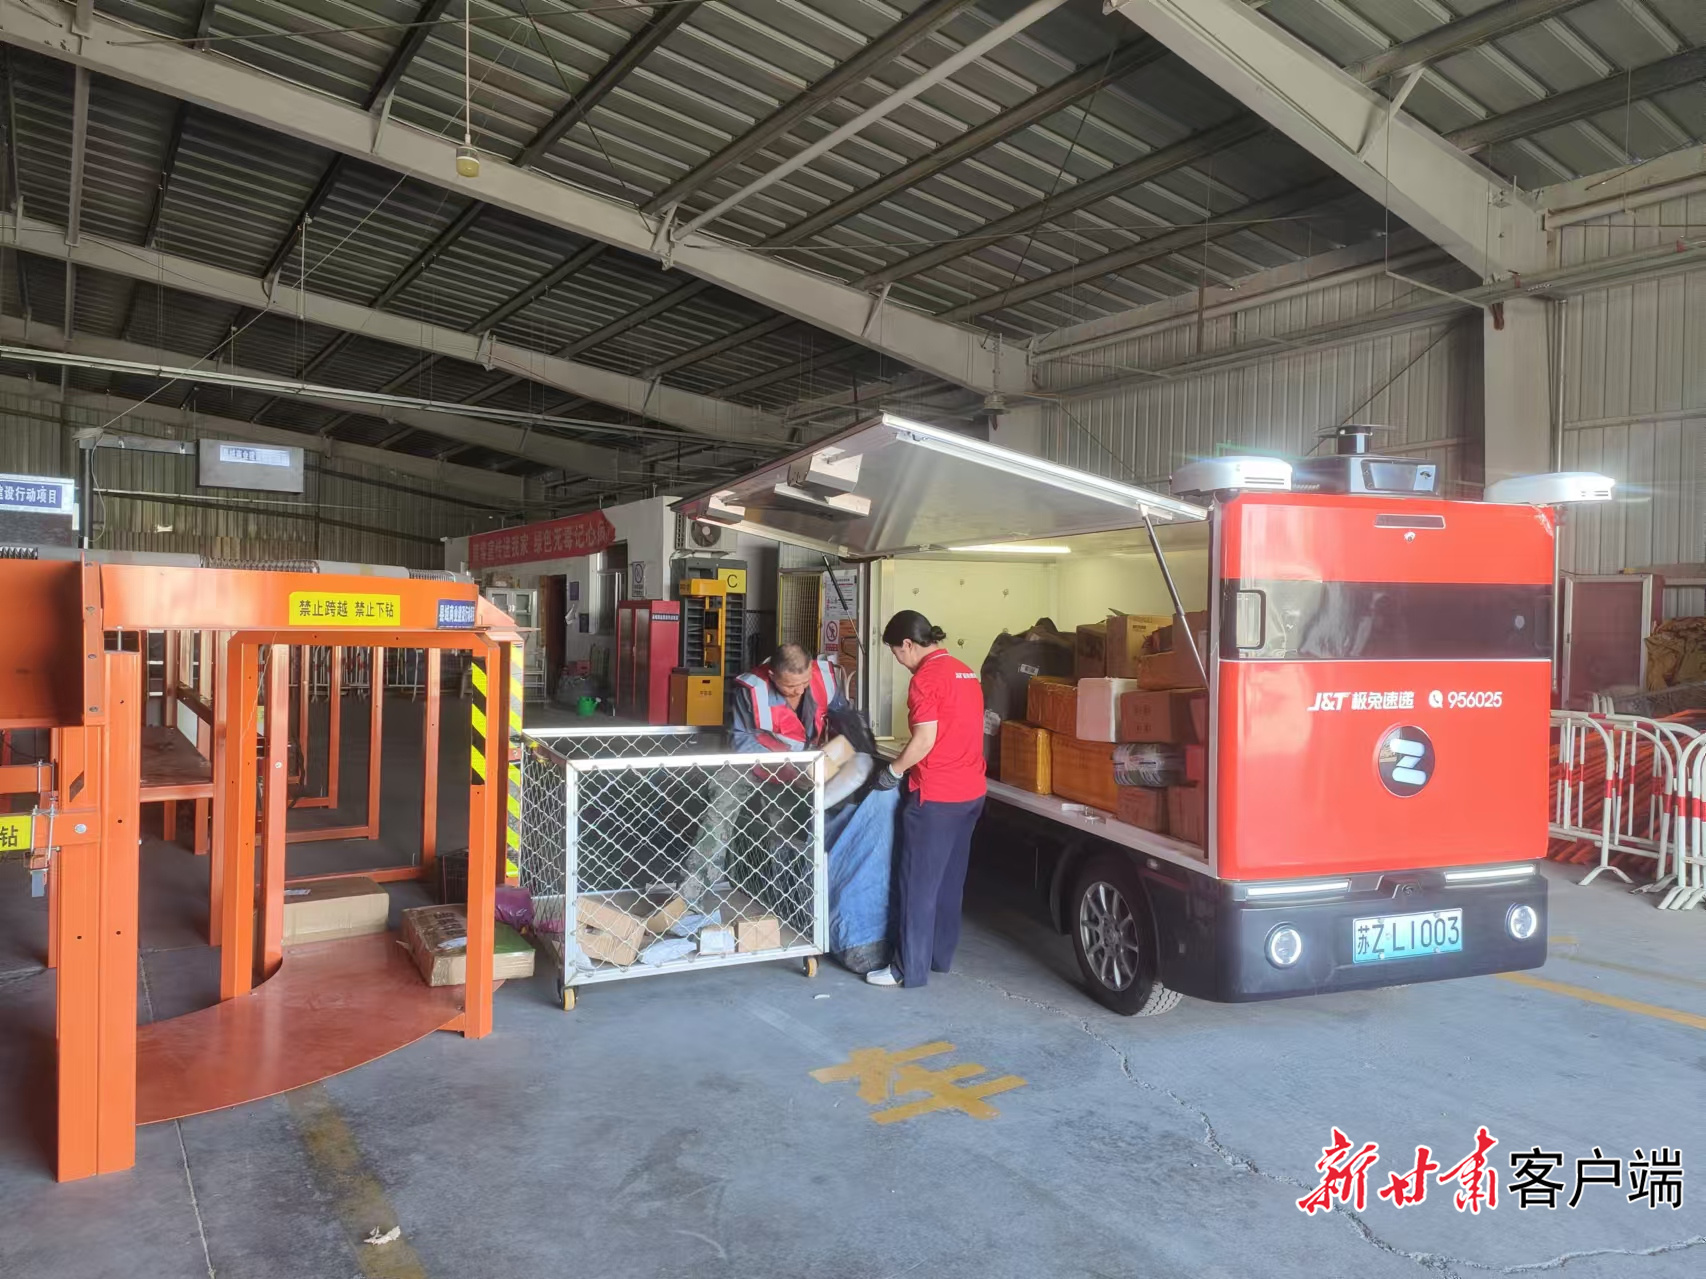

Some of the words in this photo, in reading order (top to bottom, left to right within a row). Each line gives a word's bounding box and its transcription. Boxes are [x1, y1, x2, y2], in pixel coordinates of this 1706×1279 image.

[727, 574, 738, 588] C
[299, 600, 348, 617] 禁止跨越
[354, 601, 394, 618] 禁止下钻
[1448, 691, 1502, 709] 956025
[0, 825, 18, 847] 钻
